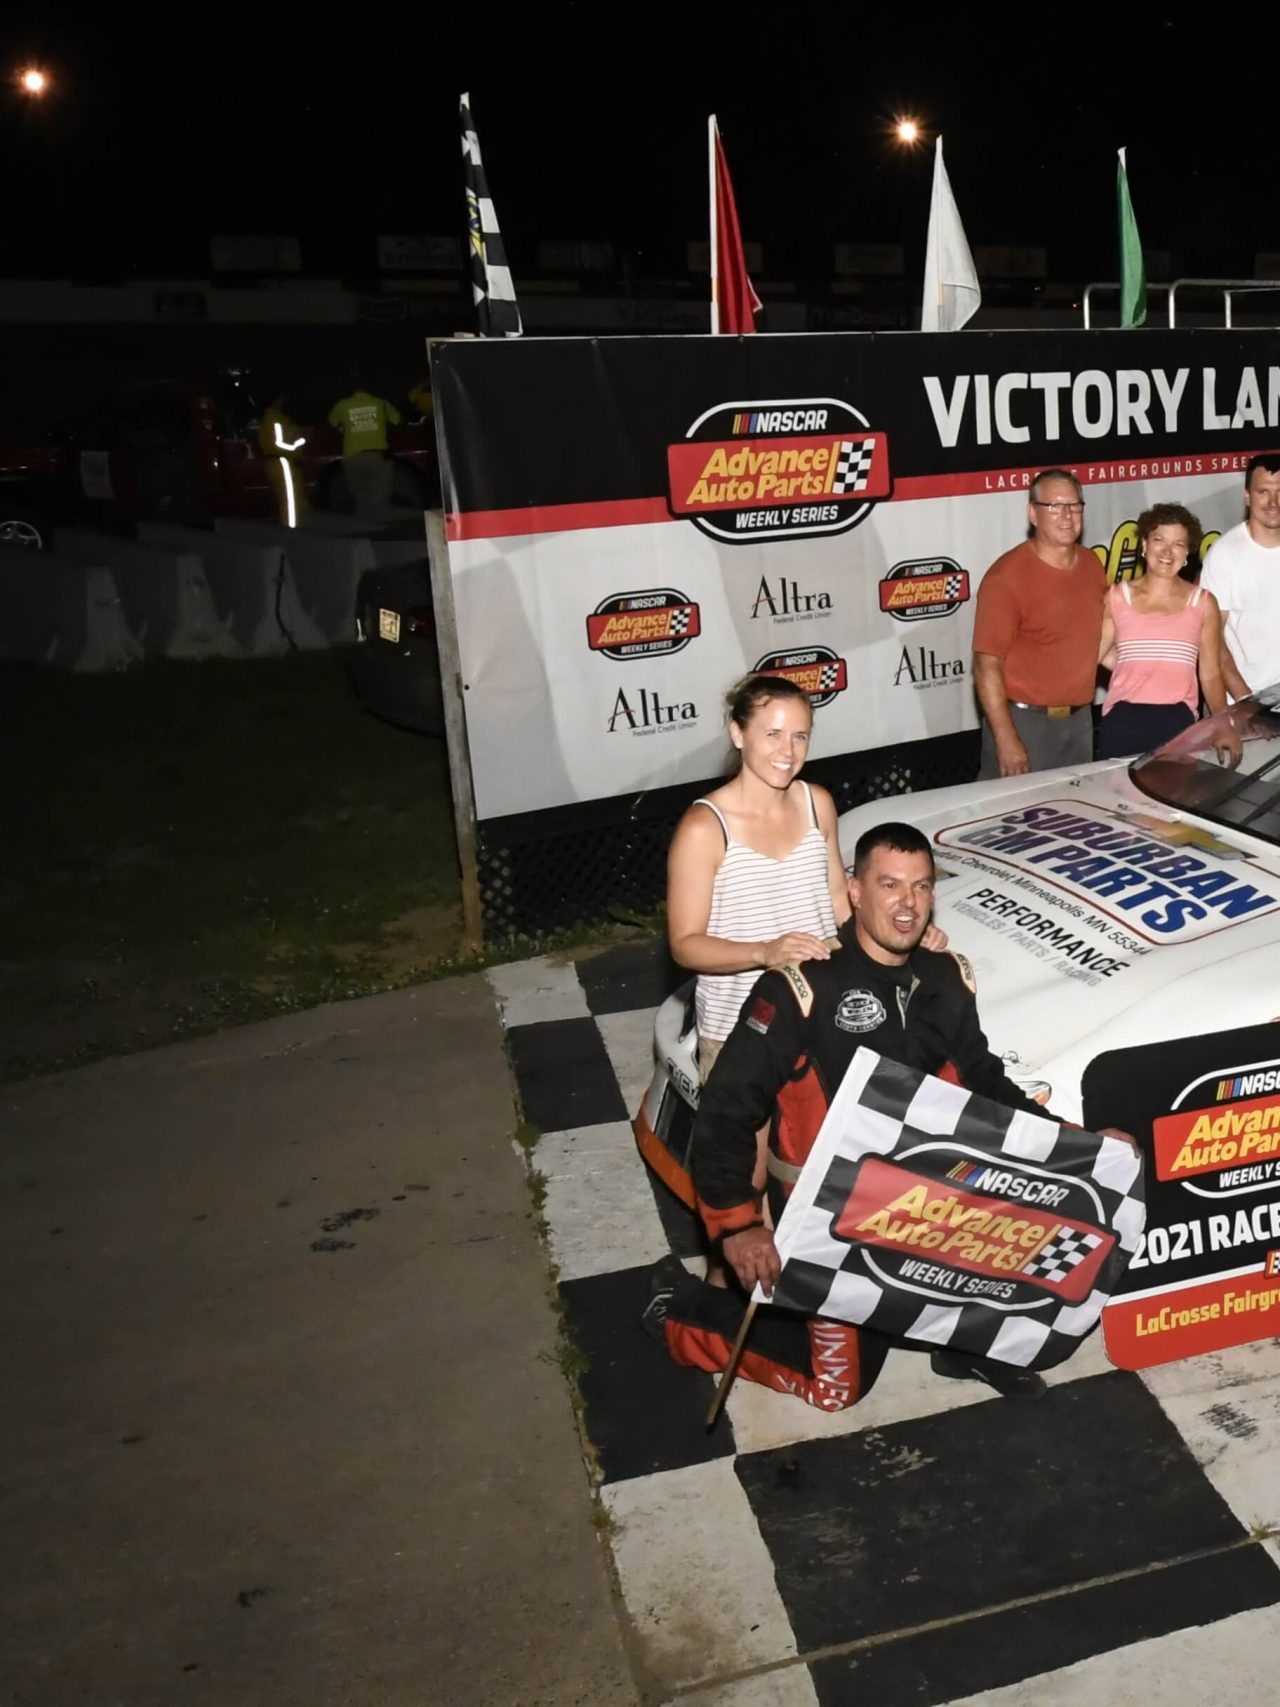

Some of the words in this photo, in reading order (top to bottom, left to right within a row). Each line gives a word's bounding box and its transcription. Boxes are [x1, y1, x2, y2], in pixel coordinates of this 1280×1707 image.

[755, 409, 828, 434] NASCAR
[922, 367, 1191, 448] VICTORY
[700, 446, 829, 479] Advance
[984, 468, 1078, 490] LACRE
[1088, 458, 1203, 481] FAIRGROUNDS
[1211, 456, 1253, 472] SPEE
[685, 478, 754, 505] Auto
[755, 471, 826, 499] Parts
[735, 508, 791, 530] WEEKLY
[791, 504, 840, 524] SERIES
[630, 595, 667, 609] NASCAR
[750, 574, 834, 619] Altra
[886, 593, 914, 607] Auto
[914, 591, 941, 604] Parts
[893, 579, 943, 595] Advance
[597, 630, 631, 645] Auto
[631, 625, 665, 640] Parts
[605, 612, 667, 632] Advance
[620, 643, 648, 654] WEEKLY
[893, 643, 967, 687] Altra
[606, 685, 701, 734] Altra
[956, 823, 1057, 856] GM
[1027, 844, 1208, 935] PARTS
[1000, 805, 1279, 921] SUBURBAN
[961, 857, 1017, 882] Chevrolet
[1011, 877, 1086, 920] Minneapolis
[1083, 914, 1113, 934] MN
[951, 900, 1008, 932] VEHICLES
[1007, 930, 1051, 959] PARTS
[1052, 960, 1104, 988] RACING
[966, 887, 1131, 978] PERFORMANCE
[1169, 1141, 1238, 1173] Auto
[1219, 1161, 1274, 1189] WEEKLY
[974, 1167, 1070, 1208] NASCAR
[885, 1183, 1047, 1248] Advance
[855, 1208, 946, 1249] Auto
[940, 1230, 1025, 1272] Parts
[1128, 1218, 1204, 1270] 2021
[897, 1257, 968, 1290] WEEKLY
[964, 1278, 1018, 1300] SERIES
[1135, 1302, 1221, 1337] LaCrosse
